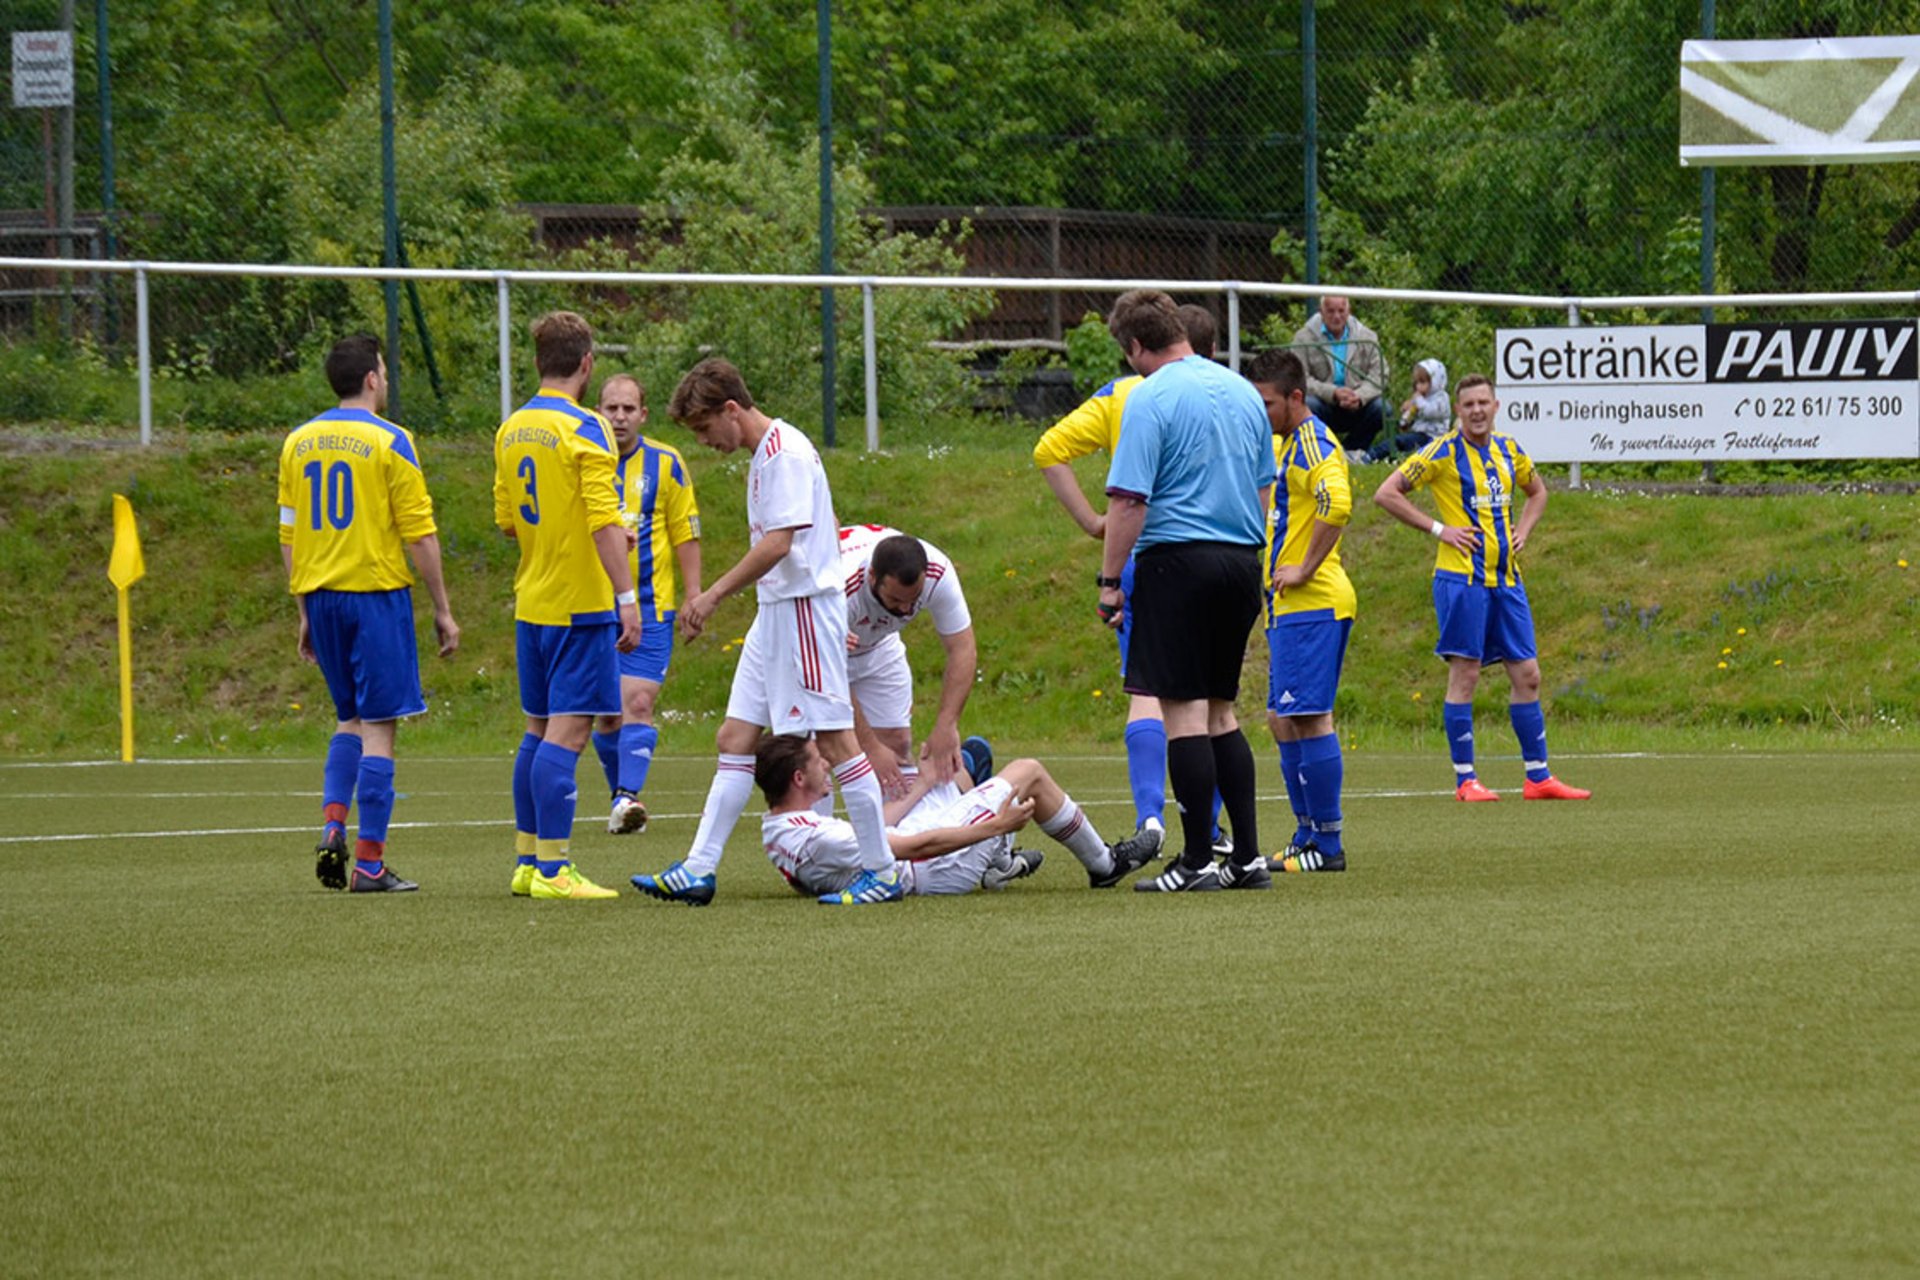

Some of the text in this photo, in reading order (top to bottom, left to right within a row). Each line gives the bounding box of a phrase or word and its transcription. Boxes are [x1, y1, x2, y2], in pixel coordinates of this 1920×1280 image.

[1503, 327, 1914, 380] Getränke PAULY
[1508, 401, 1540, 421] GM
[1559, 400, 1703, 424] Dieringhausen
[1754, 397, 1766, 417] 0
[1773, 397, 1796, 417] 22
[1838, 397, 1861, 416] 75
[1868, 396, 1902, 416] 300
[317, 435, 375, 459] BIELSTEIN
[1590, 431, 1820, 455] Ihr zuverlässiger Festlieferant
[303, 460, 354, 531] 10
[518, 455, 540, 526] 3
